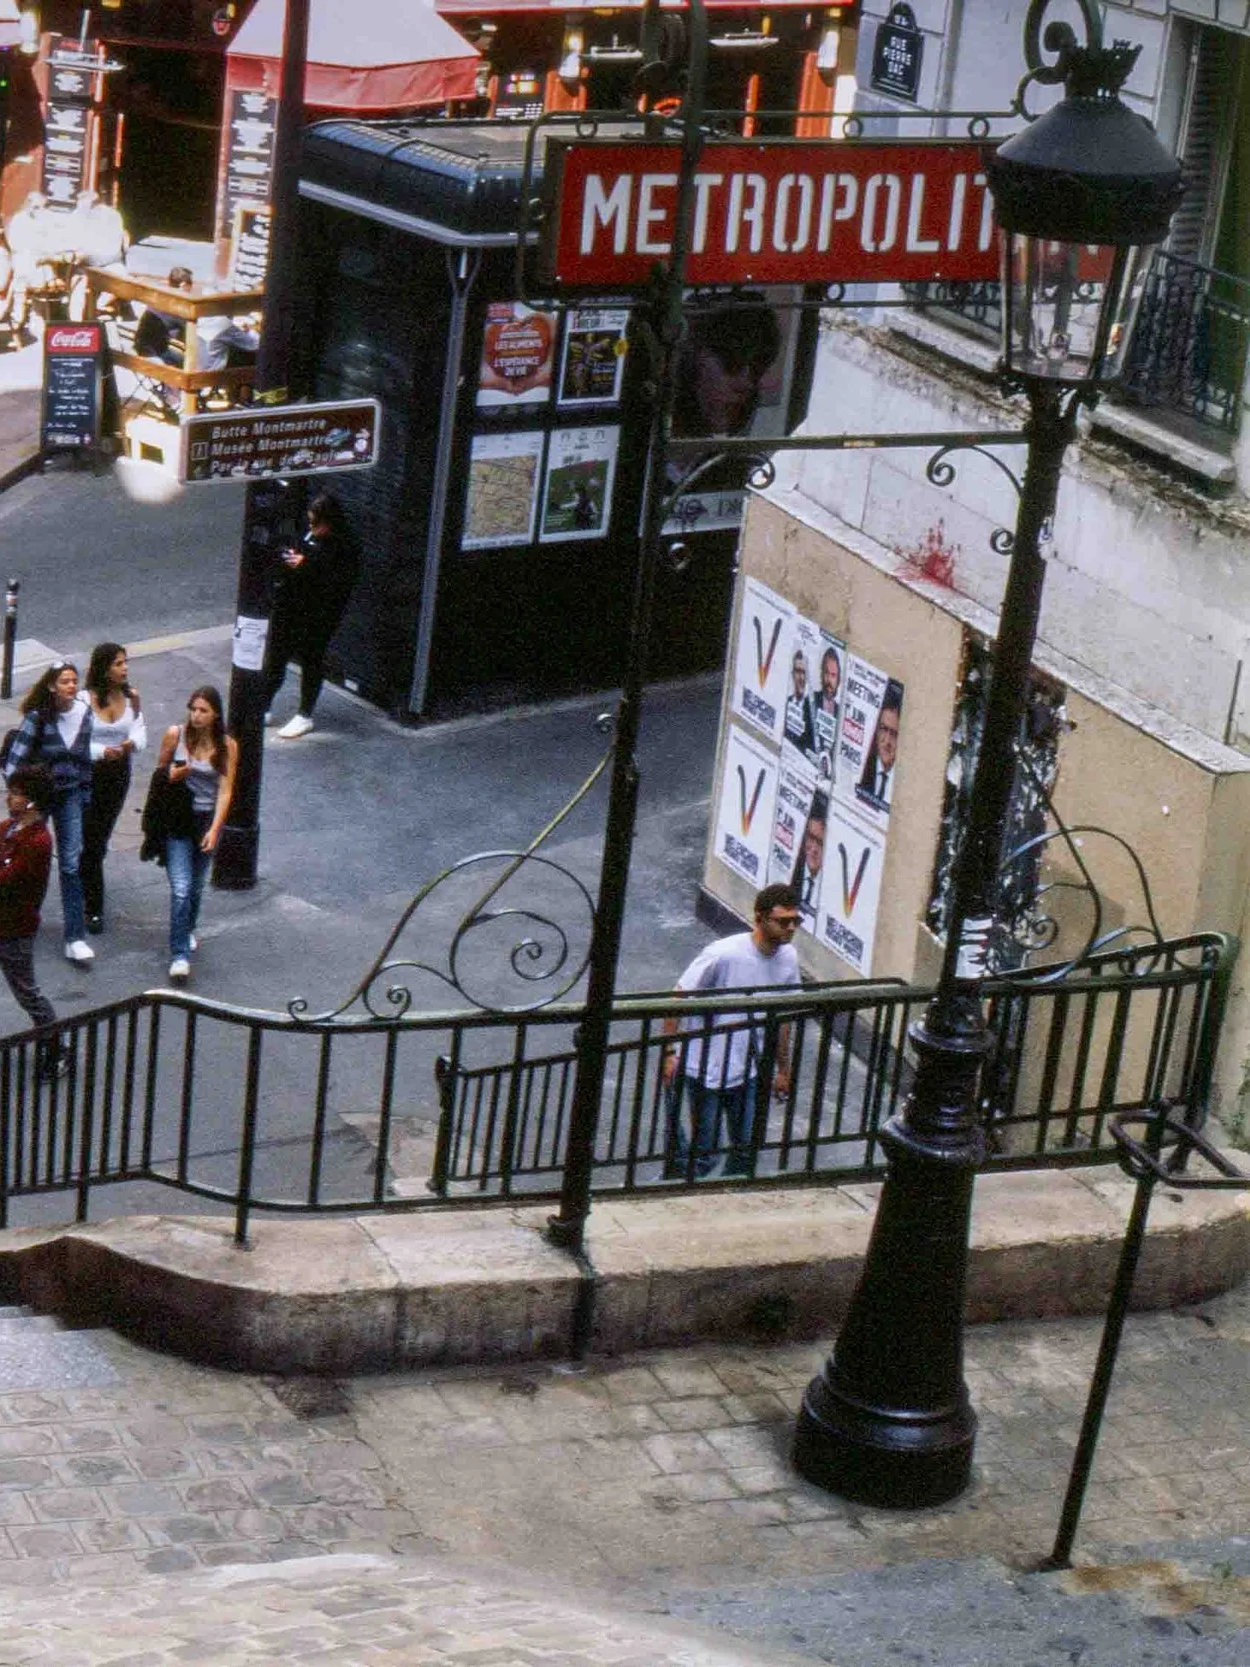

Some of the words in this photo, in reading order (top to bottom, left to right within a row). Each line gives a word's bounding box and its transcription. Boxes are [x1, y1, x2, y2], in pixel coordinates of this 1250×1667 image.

[579, 172, 1098, 257] METROPOLIT
[211, 424, 248, 440] Butte
[252, 418, 327, 436] Montmartre
[211, 440, 255, 456] Musée
[258, 434, 333, 451] Montmartre
